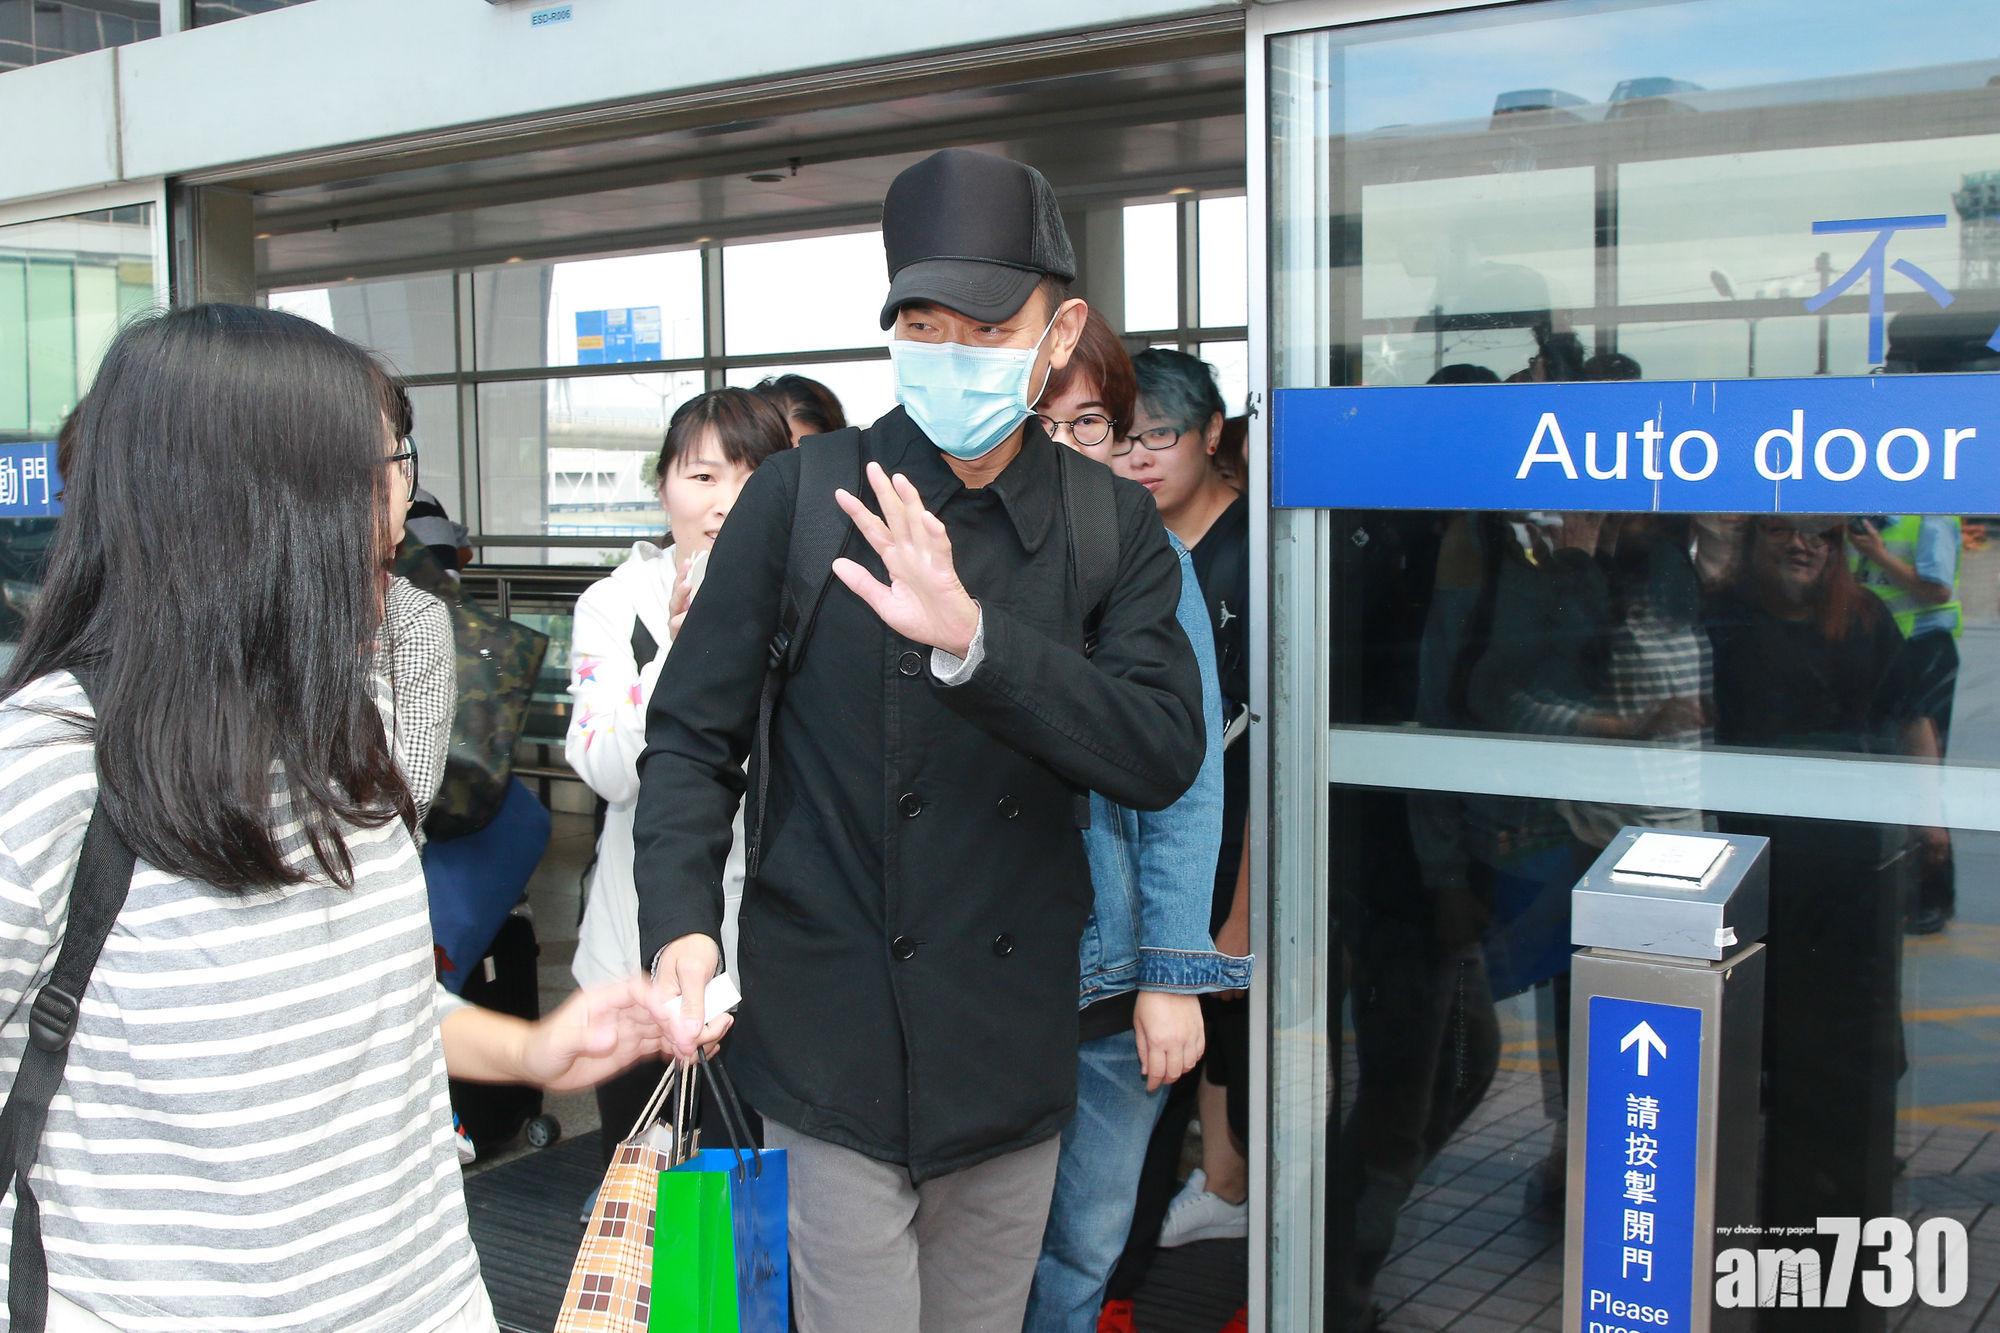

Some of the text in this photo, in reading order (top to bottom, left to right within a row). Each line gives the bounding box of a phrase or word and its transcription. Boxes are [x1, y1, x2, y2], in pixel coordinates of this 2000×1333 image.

[1803, 214, 2000, 364] 不
[1515, 409, 1977, 481] Auto door
[1621, 1092, 1660, 1283] 請按掣開門
[1590, 1289, 1669, 1326] Please
